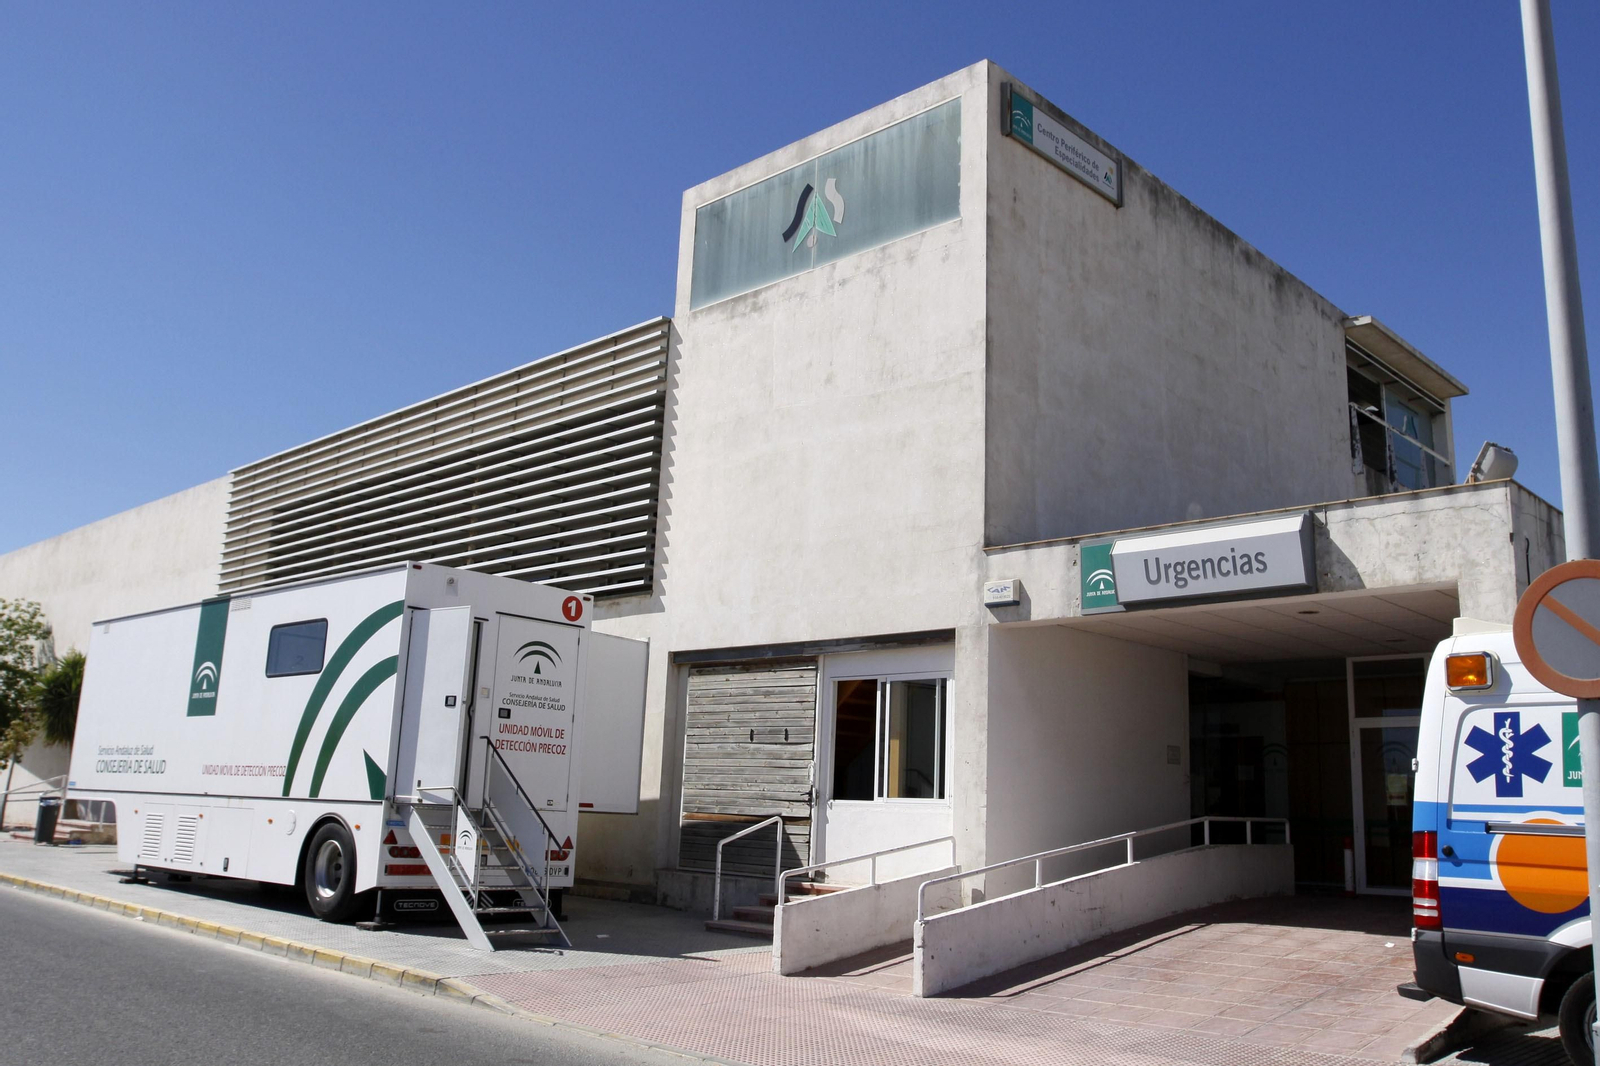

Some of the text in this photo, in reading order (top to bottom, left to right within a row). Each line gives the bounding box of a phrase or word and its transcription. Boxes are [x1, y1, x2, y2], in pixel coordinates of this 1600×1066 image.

[1037, 122, 1060, 145] Centro
[1060, 137, 1091, 166] Periférico
[1091, 159, 1100, 172] de
[1054, 145, 1100, 183] Especialidades
[1143, 547, 1268, 589] Urgencias
[567, 600, 577, 617] 1
[510, 674, 526, 683] JUNTA
[528, 676, 535, 685] DE
[508, 691, 525, 699] Servicio
[538, 701, 546, 710] DE
[546, 703, 566, 712] SALUD
[498, 723, 565, 740] UNIDAD MÓVIL DE
[494, 738, 567, 755] DETECCIÓN PRECOZ
[133, 760, 143, 774] DE
[143, 760, 166, 774] SALUD
[202, 764, 219, 775] UNIDAD
[234, 765, 241, 776] DE
[266, 766, 286, 777] PRECOZ
